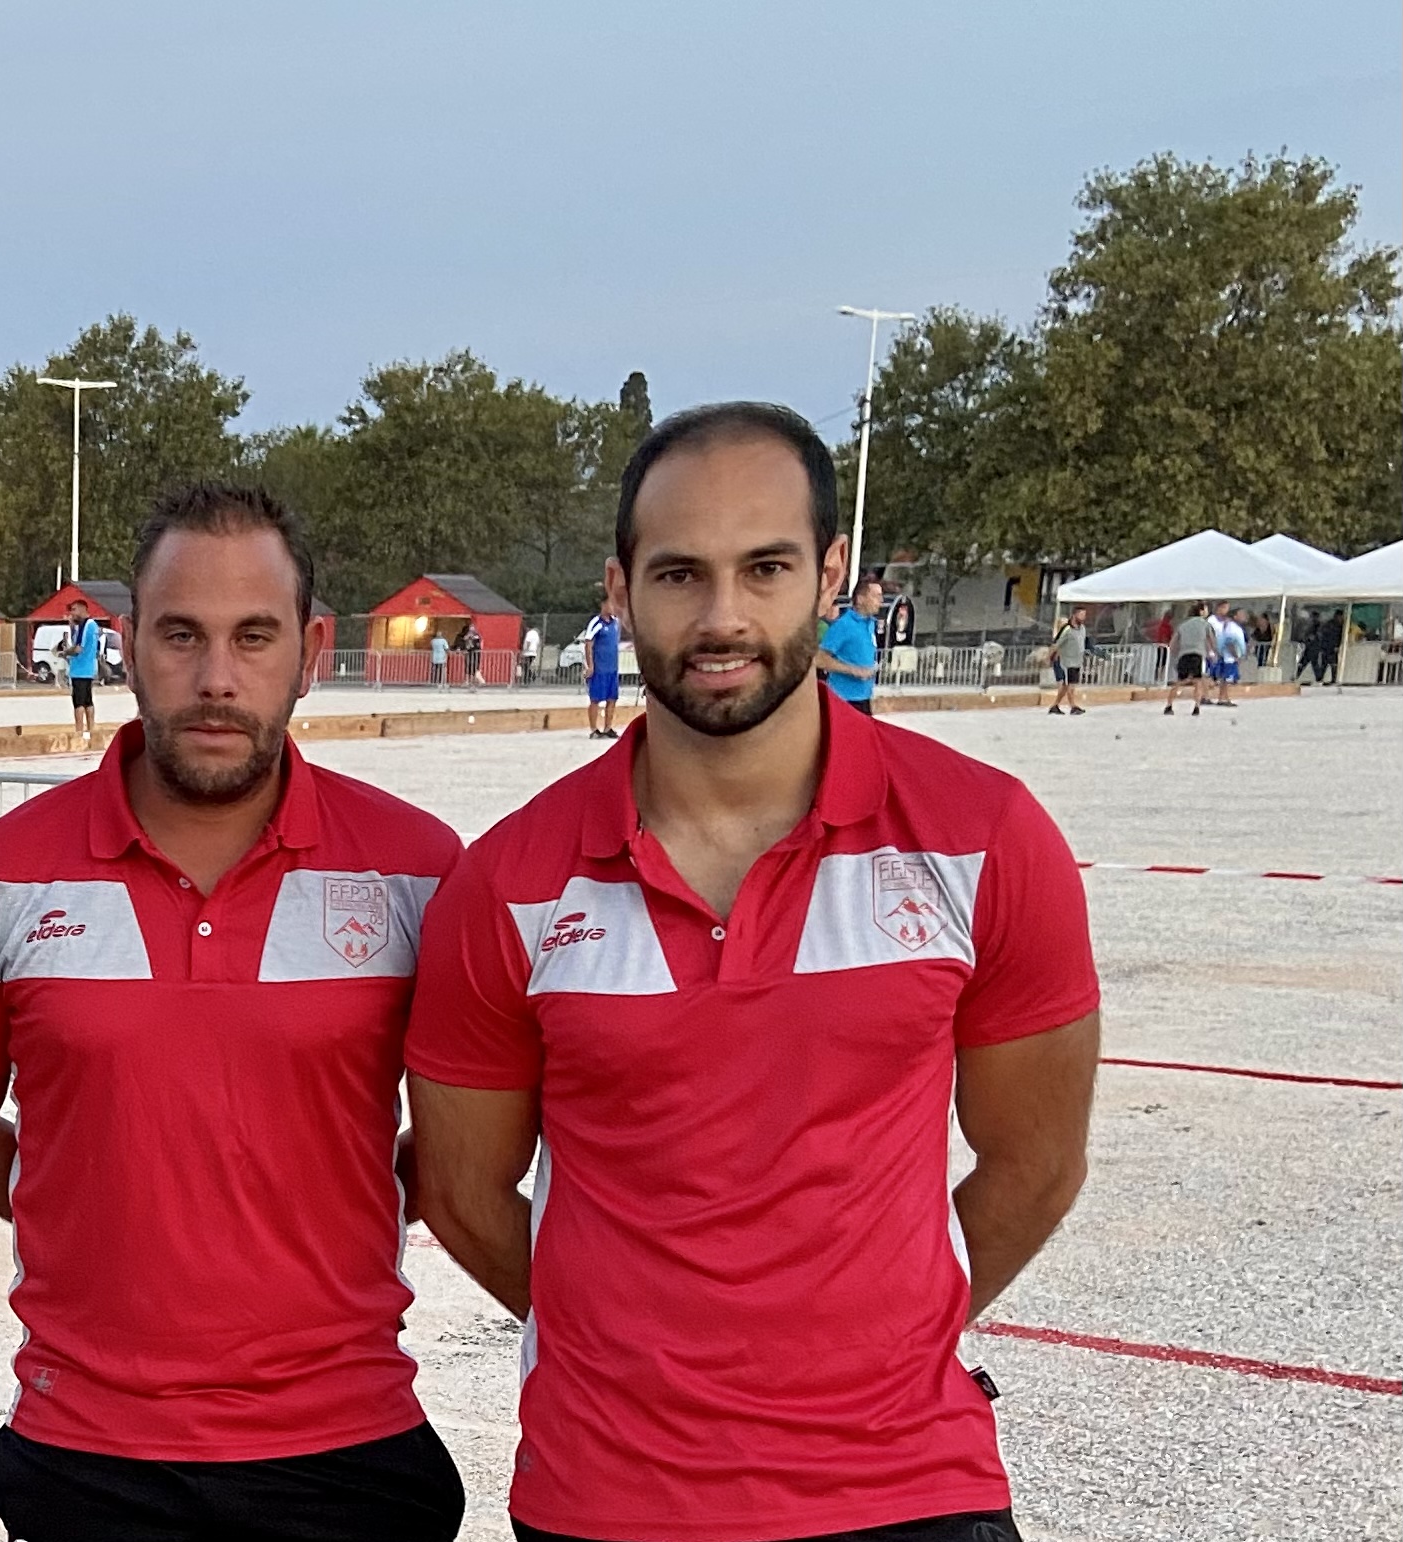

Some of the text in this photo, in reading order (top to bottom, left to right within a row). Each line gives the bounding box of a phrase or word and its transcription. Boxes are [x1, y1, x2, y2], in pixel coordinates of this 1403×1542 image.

[329, 884, 384, 902] FFPJP
[25, 922, 87, 944] eldera
[541, 927, 607, 952] eldera
